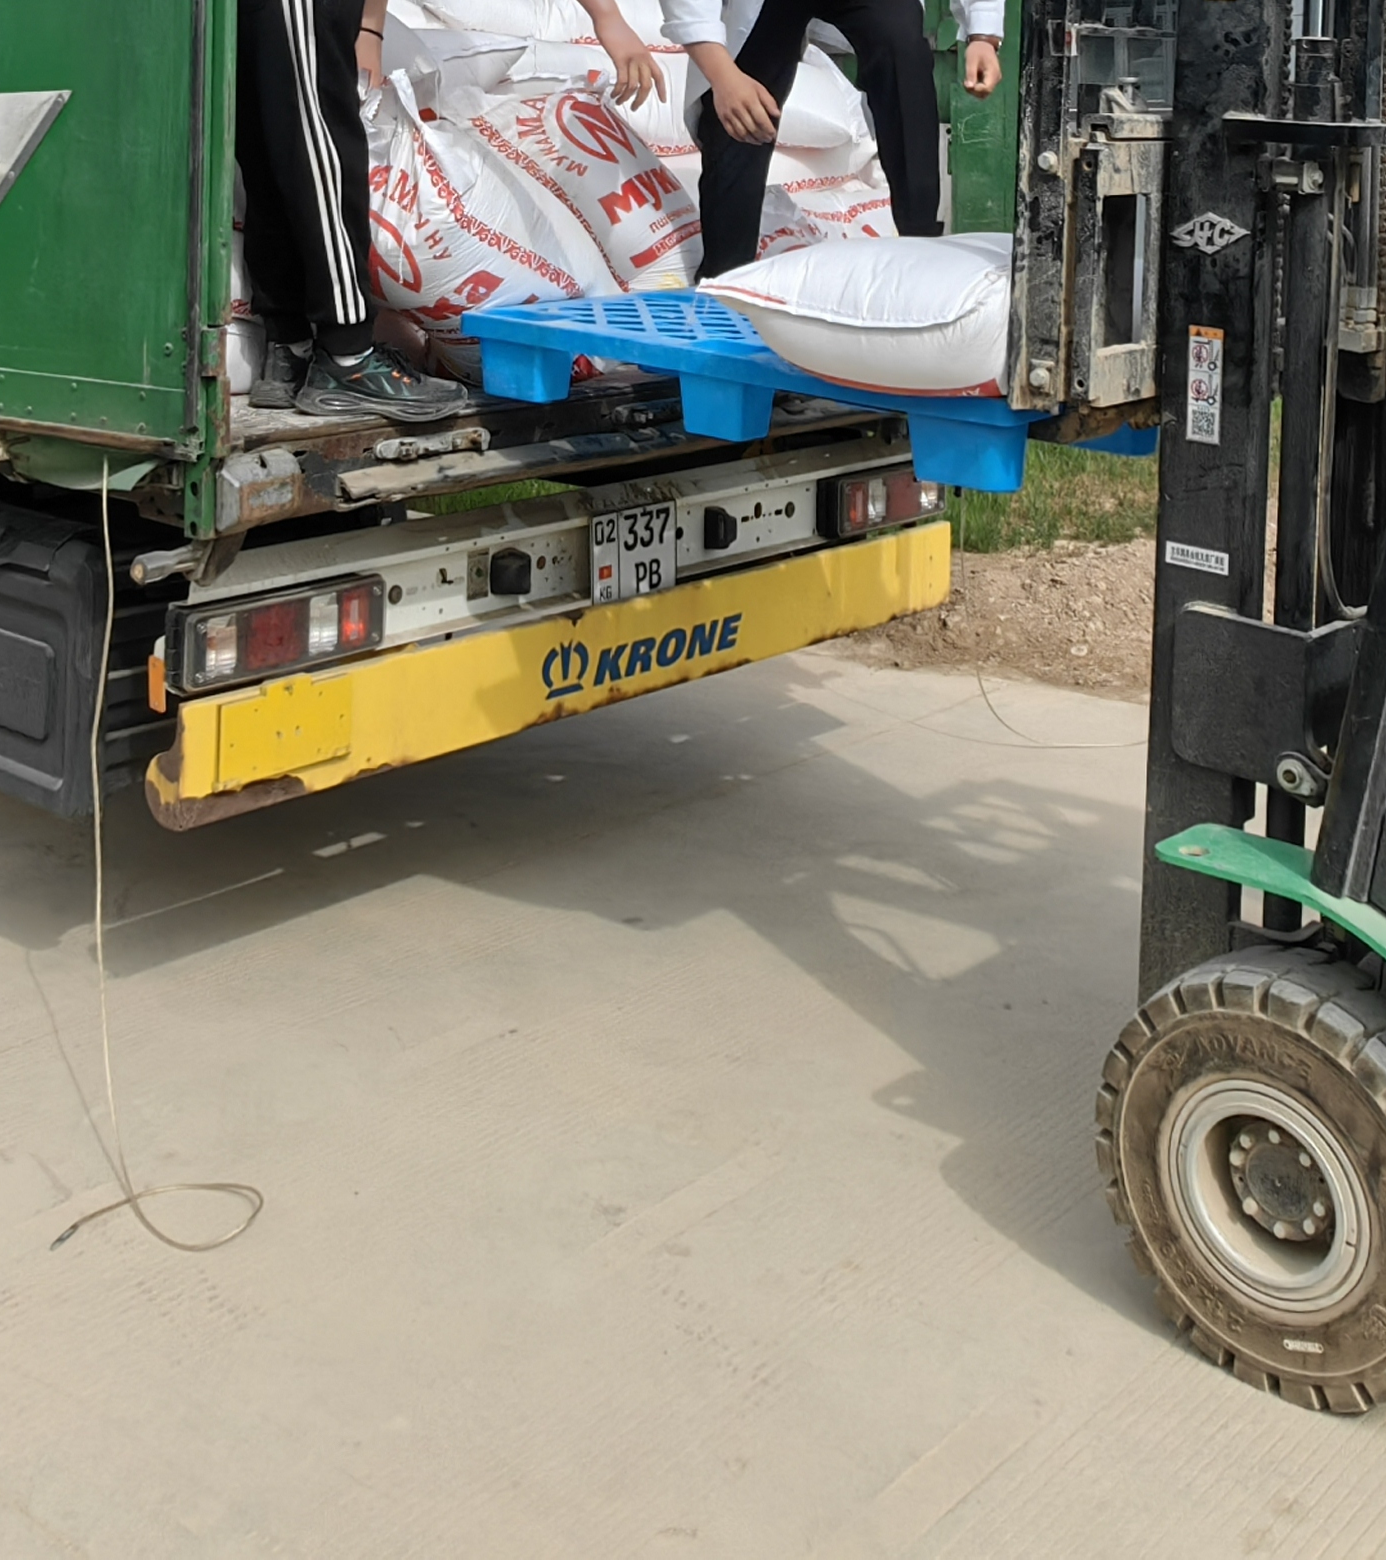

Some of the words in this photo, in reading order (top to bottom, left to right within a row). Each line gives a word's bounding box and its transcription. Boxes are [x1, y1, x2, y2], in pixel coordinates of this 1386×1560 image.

[623, 506, 670, 552] 337
[634, 558, 662, 594] PB
[593, 613, 743, 687] KRONE
